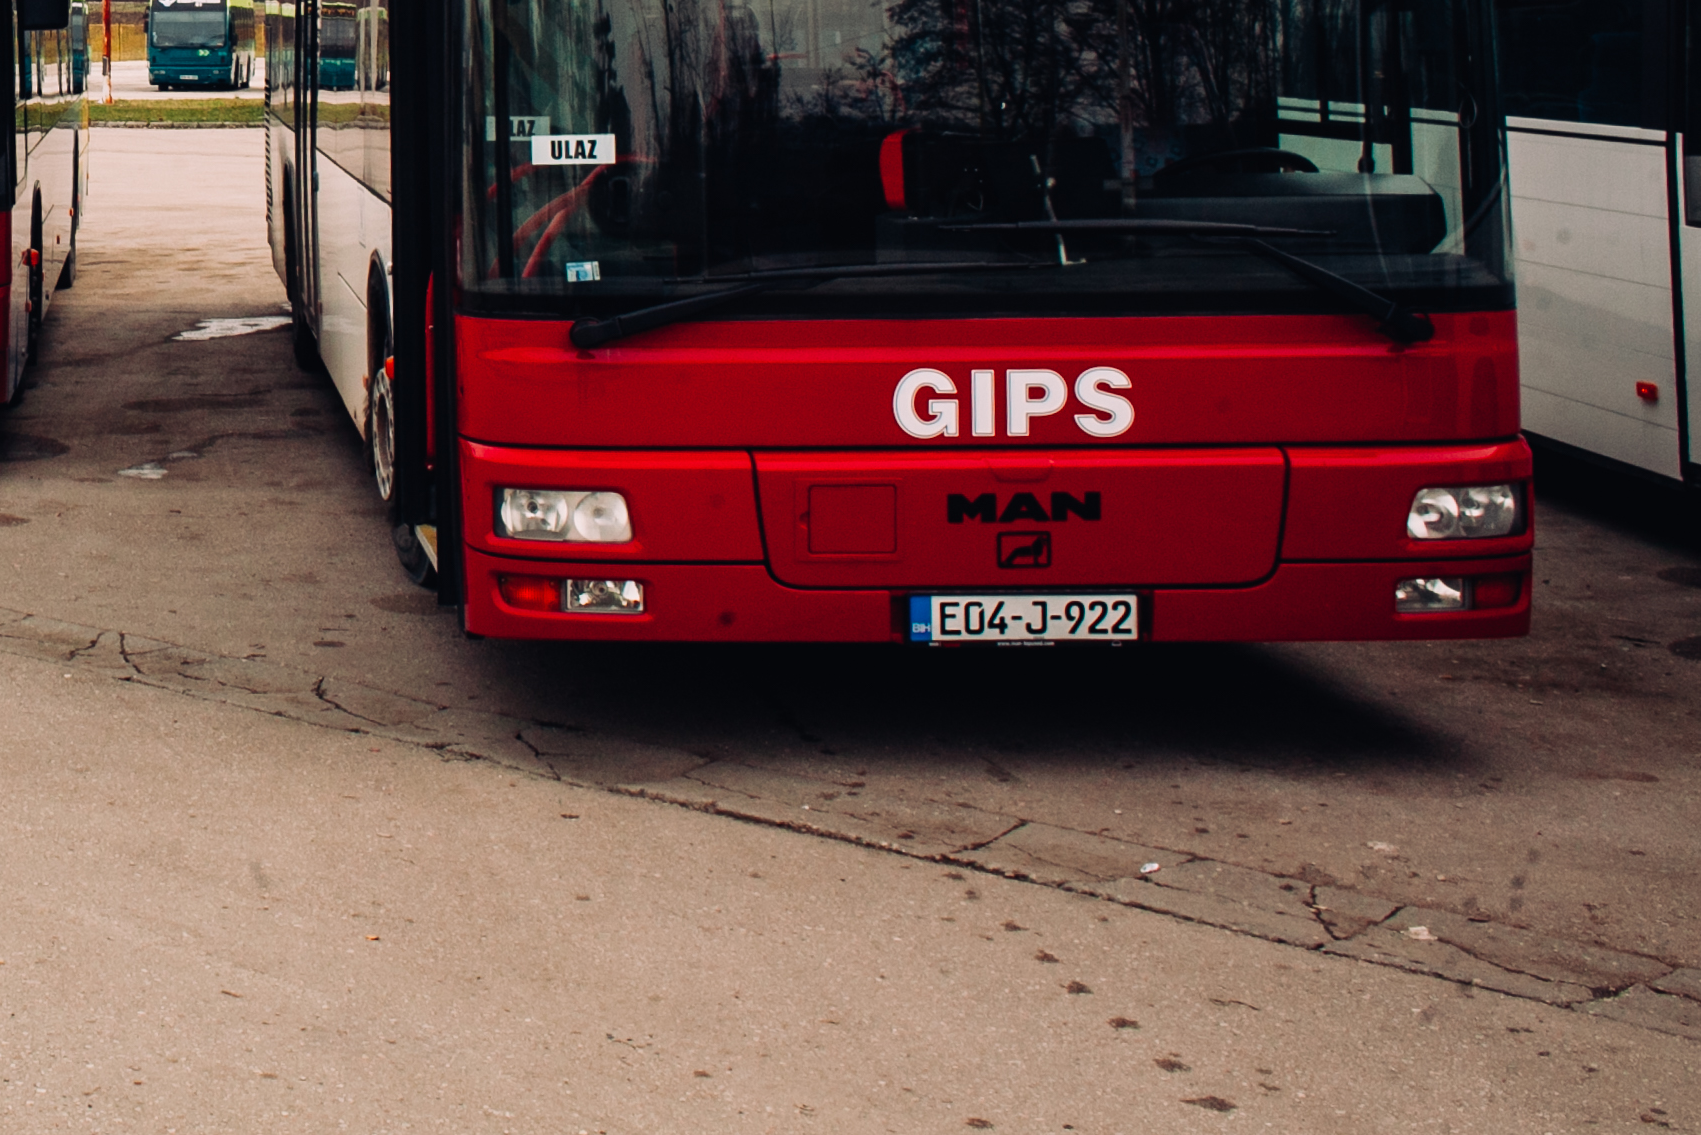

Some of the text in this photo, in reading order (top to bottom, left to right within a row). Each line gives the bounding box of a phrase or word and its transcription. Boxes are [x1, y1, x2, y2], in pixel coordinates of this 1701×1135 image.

[550, 140, 597, 160] ULAZ
[892, 366, 1135, 439] GIPS
[947, 491, 1101, 524] MAN
[939, 600, 1133, 636] E04-J-922
